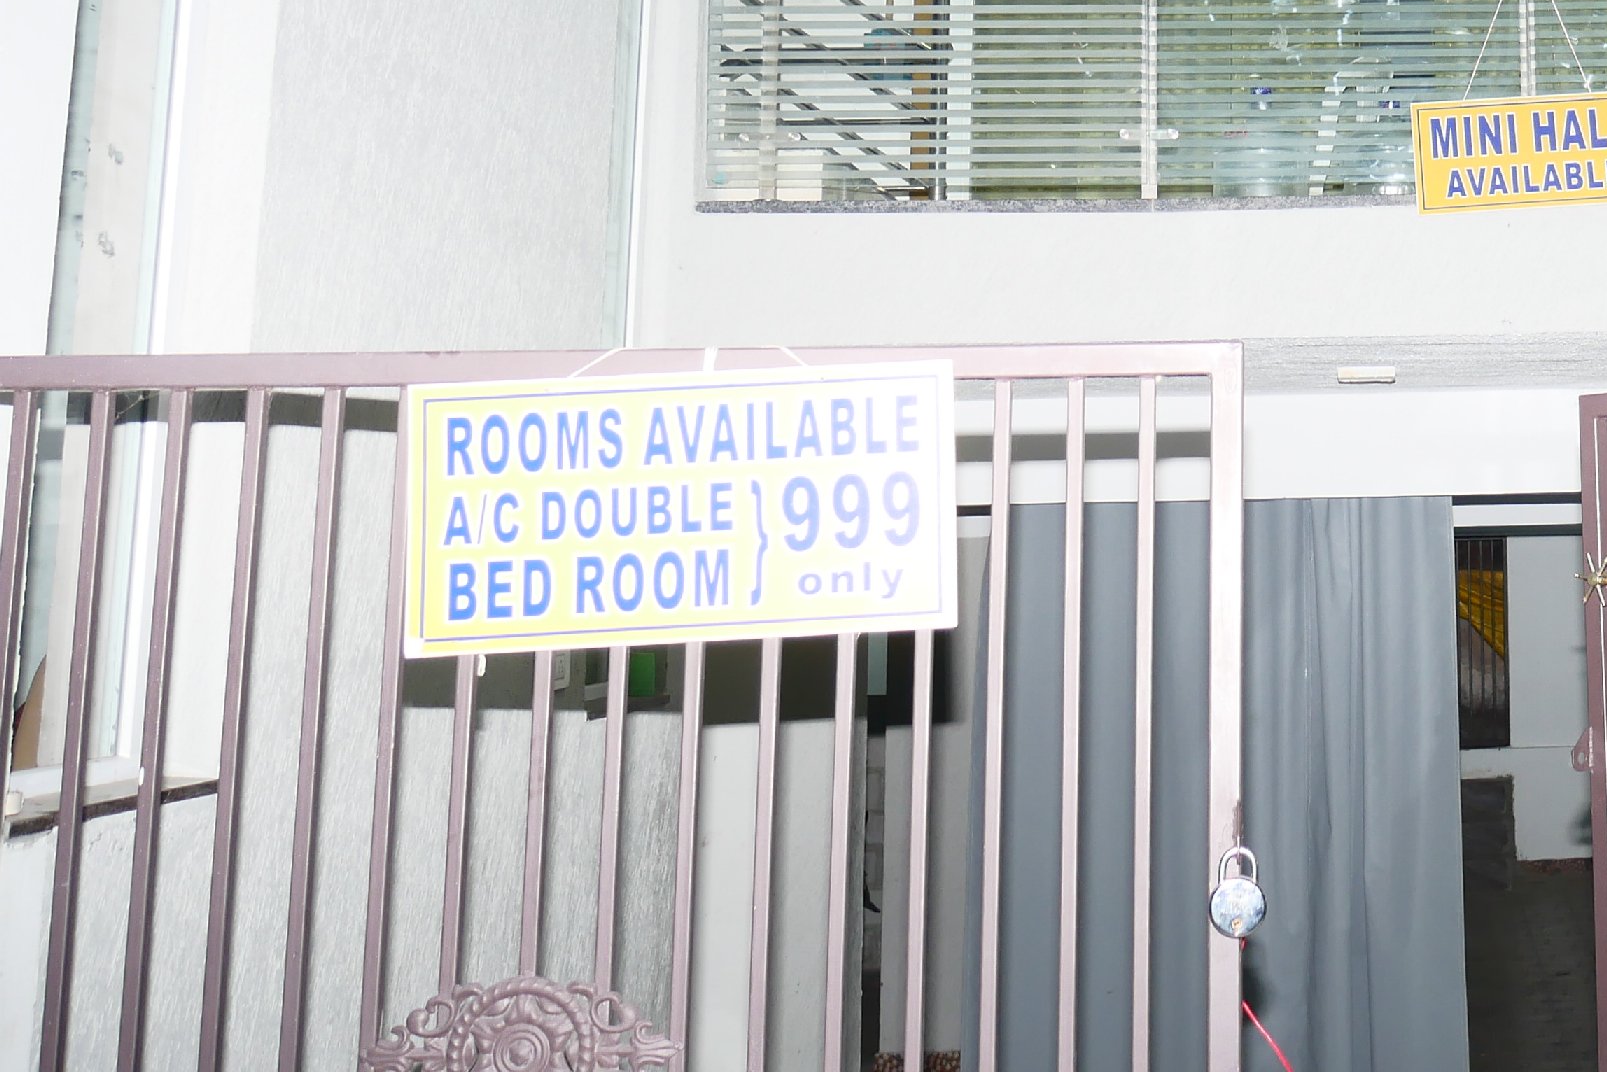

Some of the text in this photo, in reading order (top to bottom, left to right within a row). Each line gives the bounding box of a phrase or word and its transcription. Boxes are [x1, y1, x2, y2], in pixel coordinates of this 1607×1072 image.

[1430, 114, 1518, 159] MINI
[446, 394, 921, 476] ROOMS AVAILABLE
[443, 482, 733, 546] A/C DOUBLE
[782, 471, 921, 551] 999
[448, 549, 730, 621] BED ROOM
[797, 561, 903, 599] only
